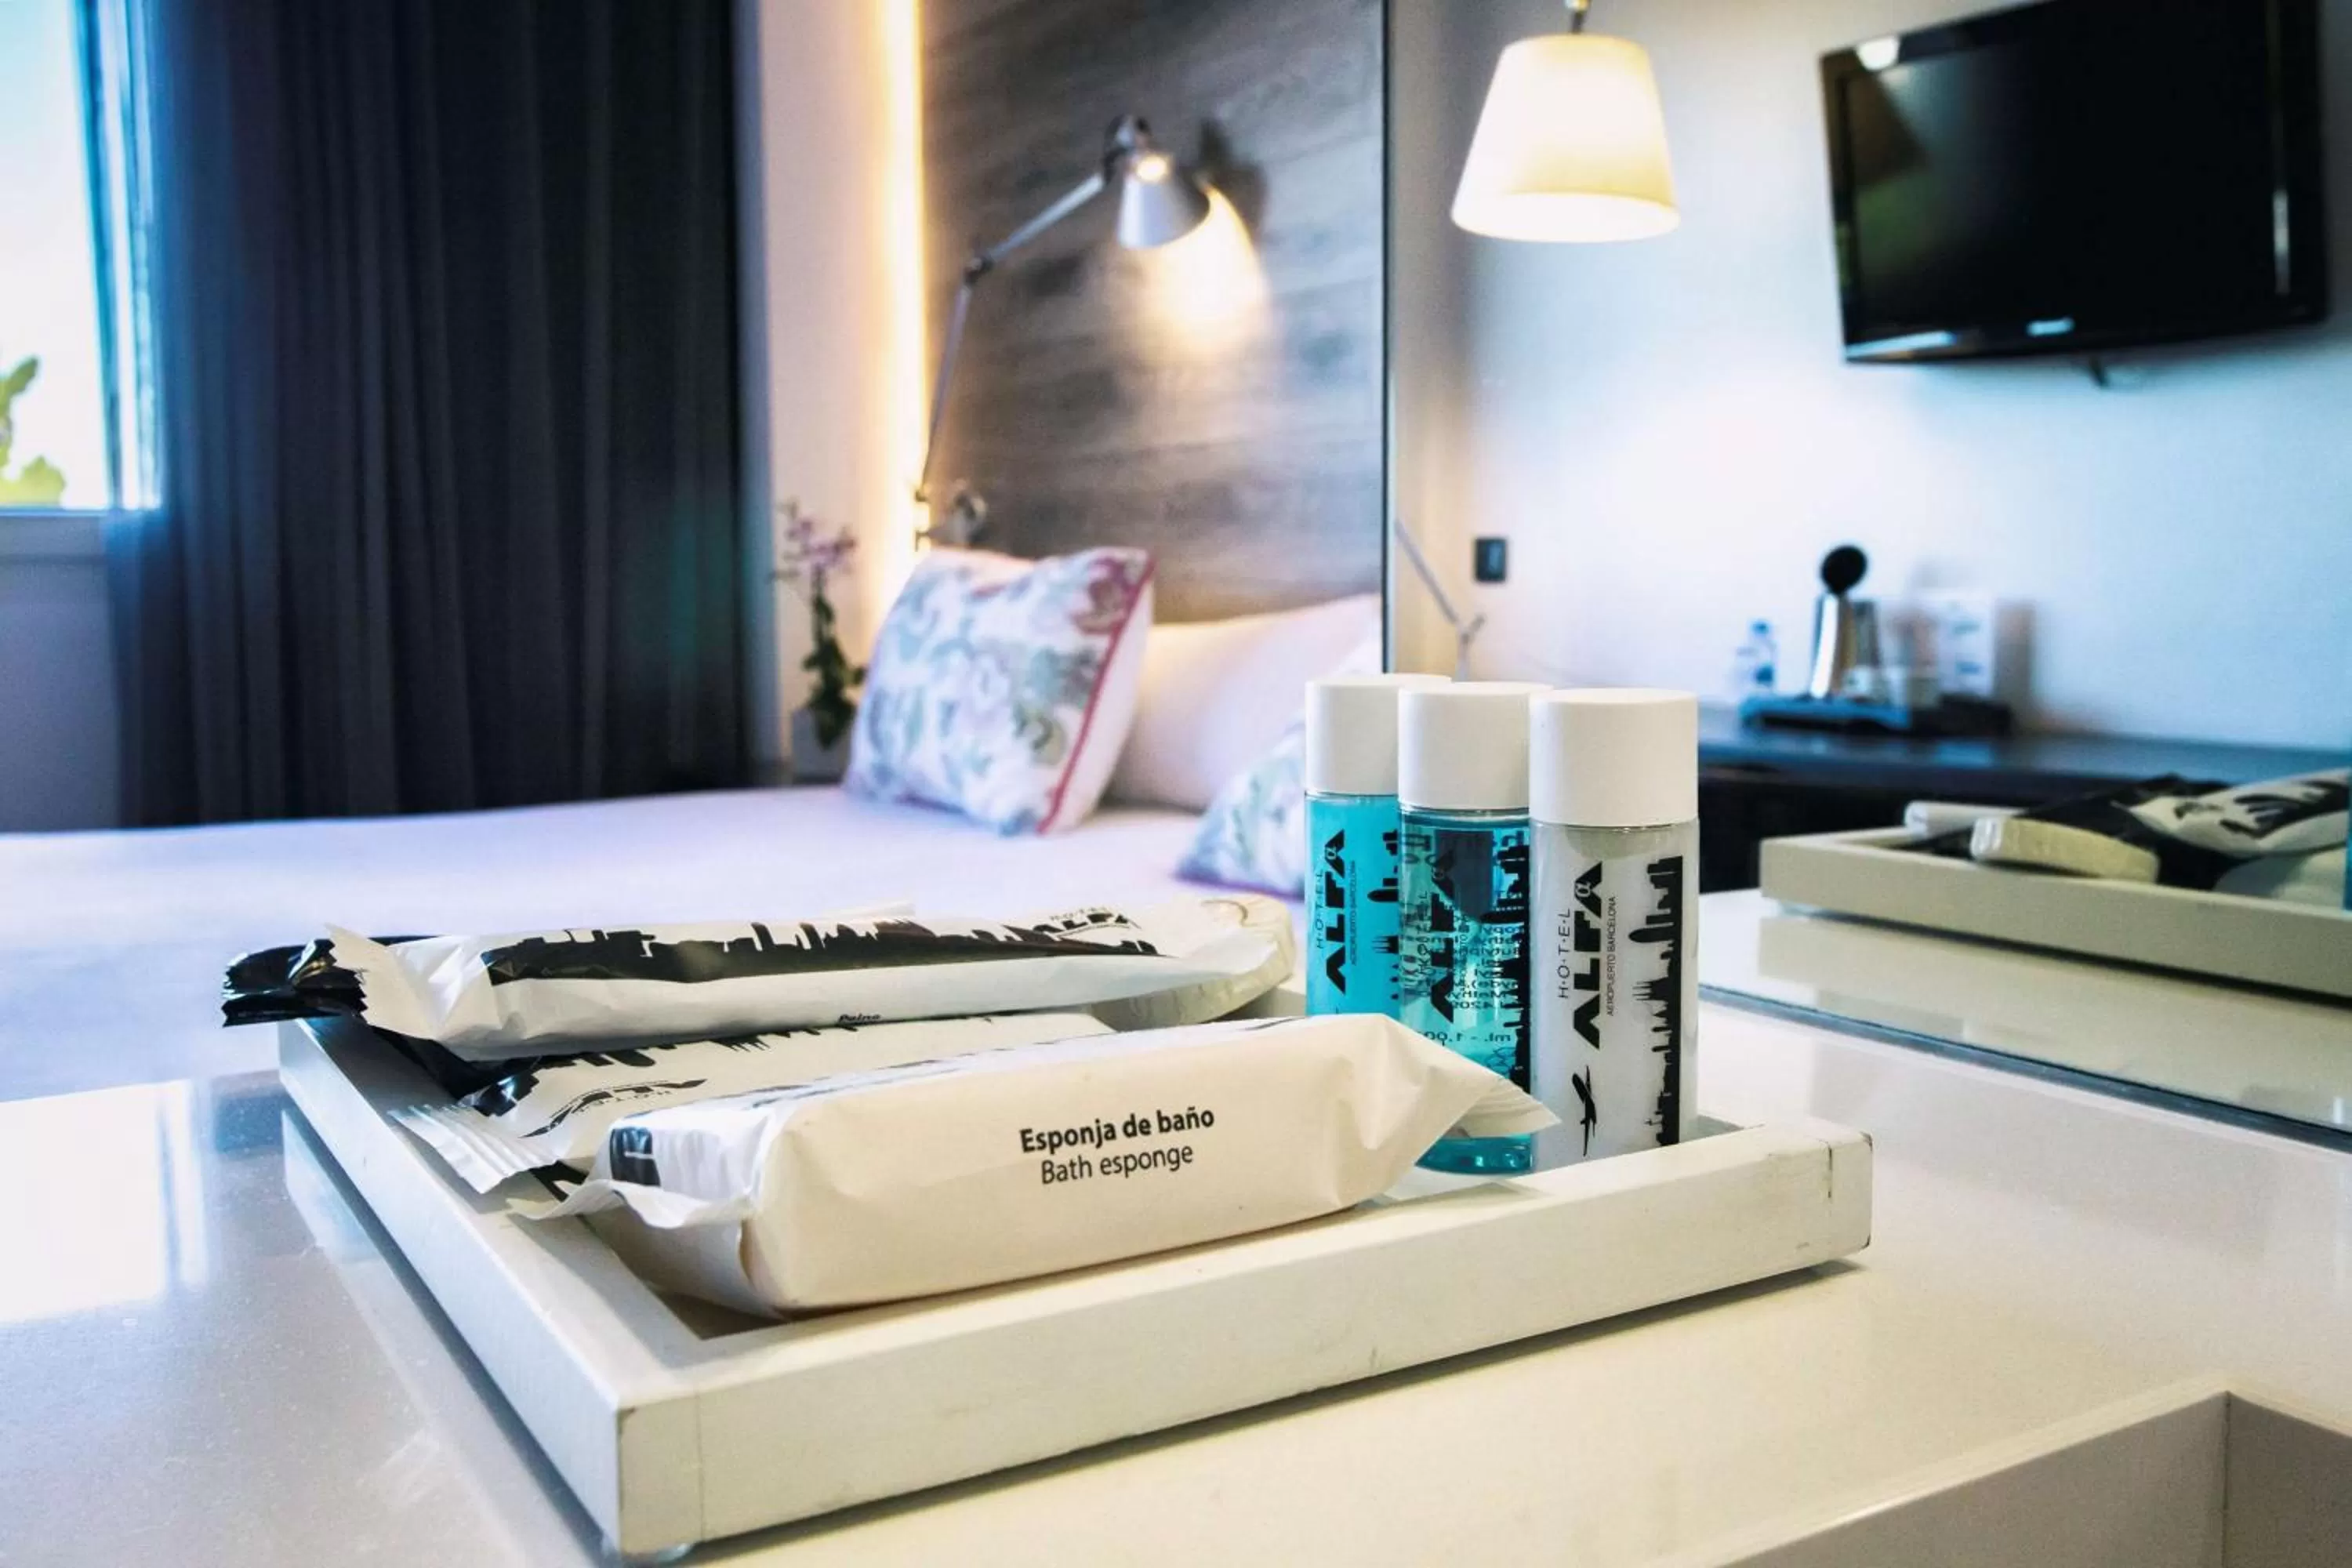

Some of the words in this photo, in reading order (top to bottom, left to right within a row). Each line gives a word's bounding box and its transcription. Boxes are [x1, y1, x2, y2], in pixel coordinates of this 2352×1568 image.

[1325, 829, 1345, 994] ALFA
[1607, 896, 1617, 952] BARCELONA
[1573, 862, 1602, 1050] ALFA
[1606, 954, 1616, 1017] AEROPUERTO
[1020, 1118, 1117, 1154] Esponja
[1122, 1112, 1152, 1138] de
[1156, 1106, 1214, 1134] baño
[1041, 1155, 1093, 1185] Bath
[1100, 1145, 1193, 1178] esponge
